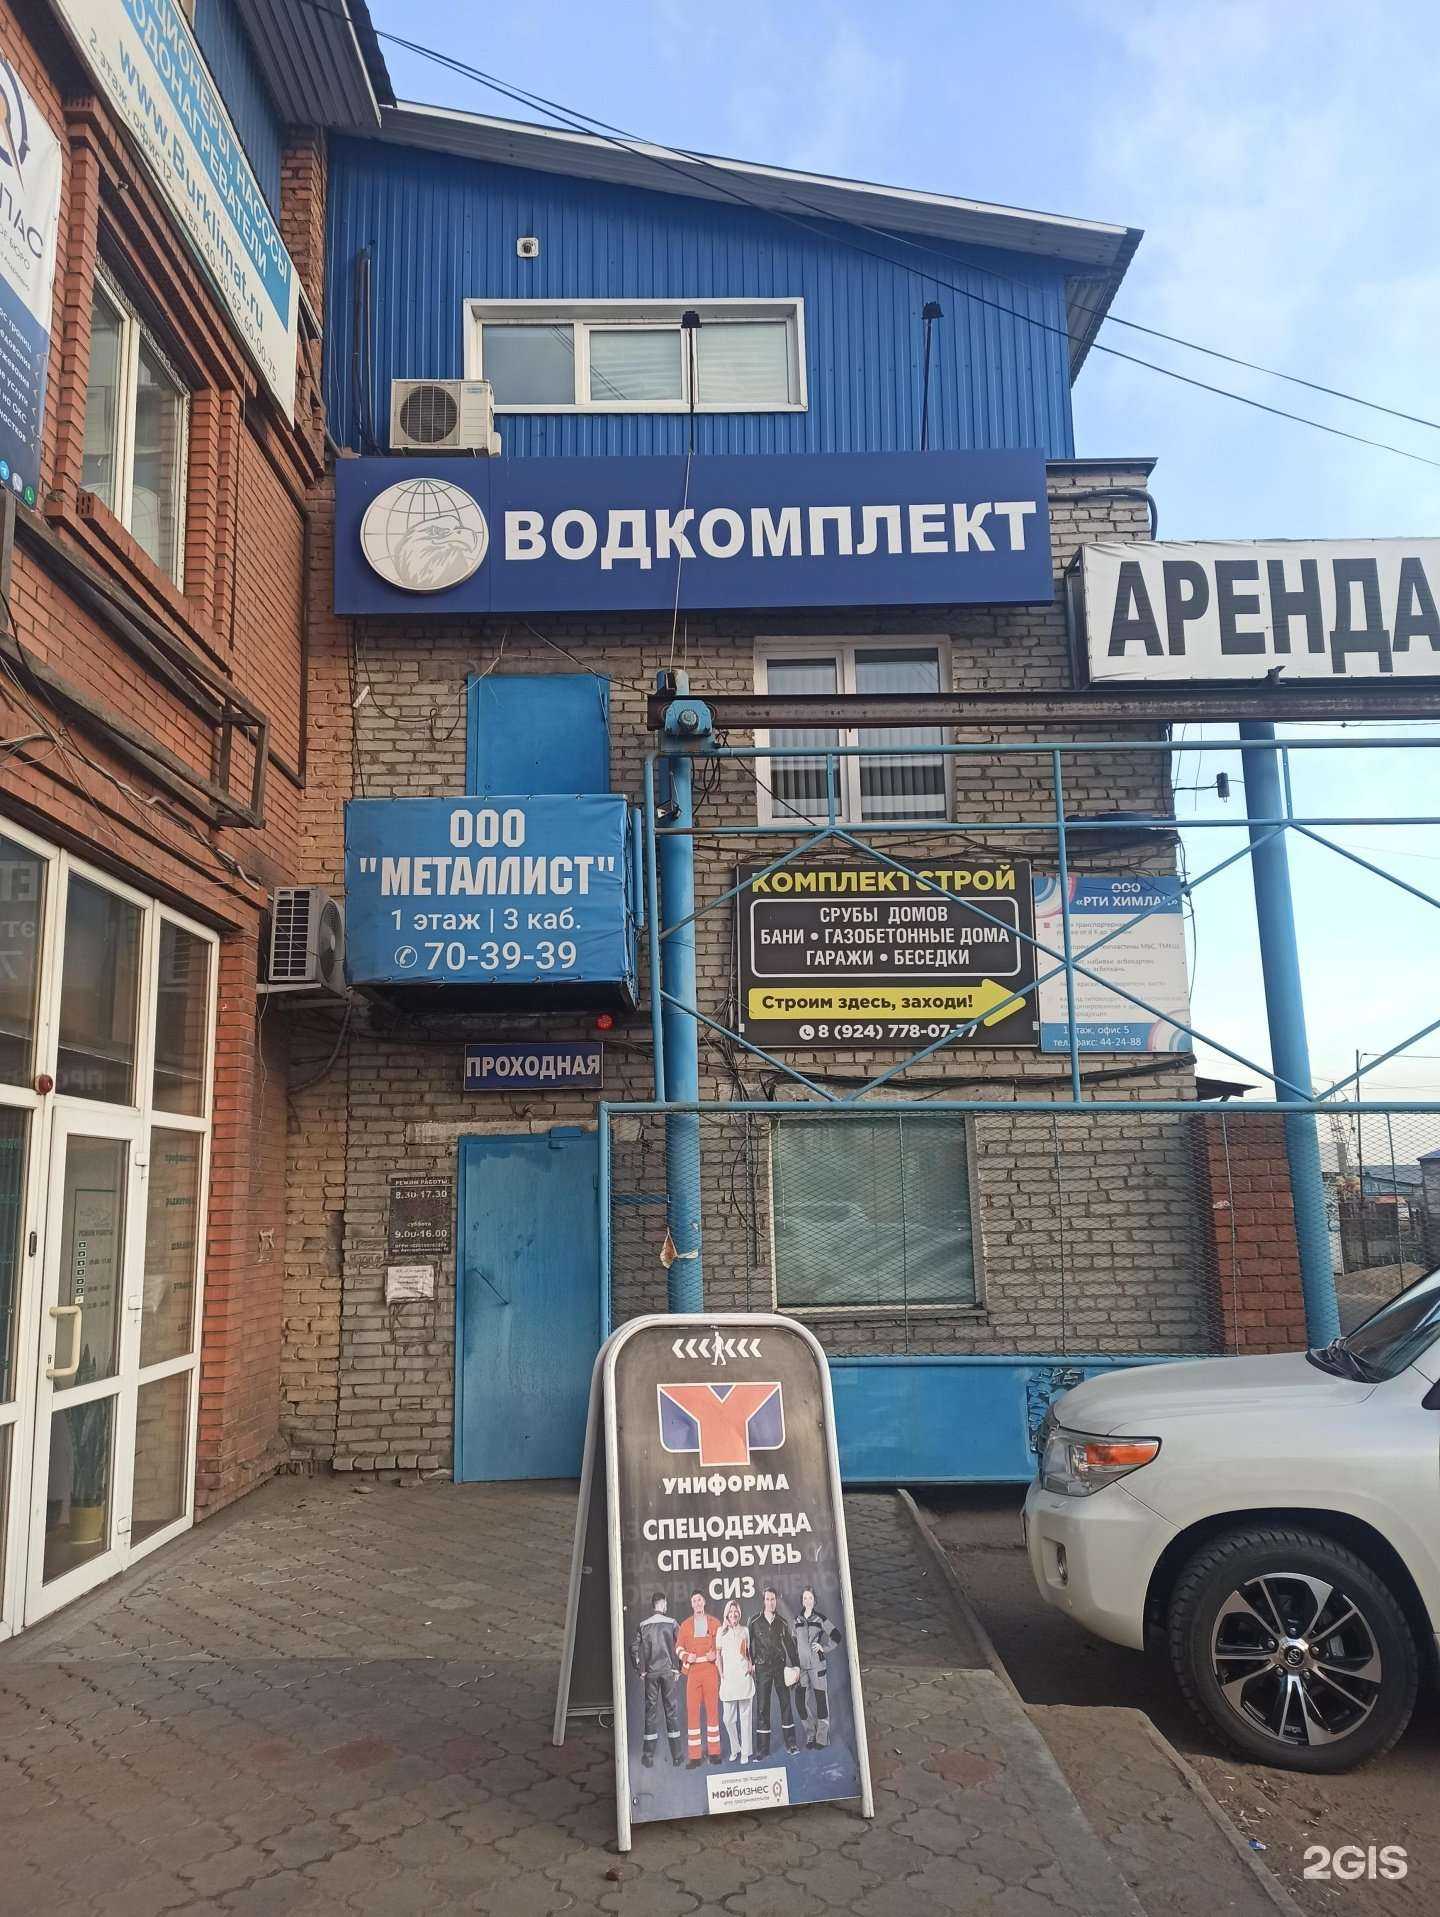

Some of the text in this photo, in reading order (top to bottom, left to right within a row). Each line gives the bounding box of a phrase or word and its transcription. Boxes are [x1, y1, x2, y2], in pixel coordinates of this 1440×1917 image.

[119, 38, 264, 333] www.Burklimat.ru
[236, 163, 288, 284] НАСОСЫ
[504, 501, 1037, 570] ВОДКОМПЛЕКТ
[1107, 557, 1440, 674] АРЕНДА
[450, 808, 526, 848] ООО
[359, 856, 615, 896] "МЕТАЛЛИСТ"
[391, 909, 402, 931] 1
[413, 912, 481, 931] этаж
[503, 908, 518, 931] 3
[527, 907, 582, 931] каб.
[820, 906, 948, 923] СРУБЫ ДОМОВ
[760, 927, 1010, 945] БАНИ ГАЗОБЕТОННЫЕ ДОМА
[424, 941, 578, 971] 70-39-39
[806, 950, 970, 967] ГАРАЖИ БЕСЕДКИ
[761, 994, 973, 1011] Строим здесь, заходи!
[818, 1025, 829, 1038] 8
[834, 1024, 883, 1039] (924)
[1097, 1026, 1121, 1037] офис
[1124, 1026, 1130, 1034] 5
[466, 1055, 601, 1079] ПРОХОДНАЯ
[662, 1474, 789, 1496] УНИФОРМА
[643, 1512, 812, 1541] СПЕЦОДЕЖДА
[657, 1544, 802, 1572] СПЕЦОБУВЬ
[709, 1576, 755, 1600] СИЗ
